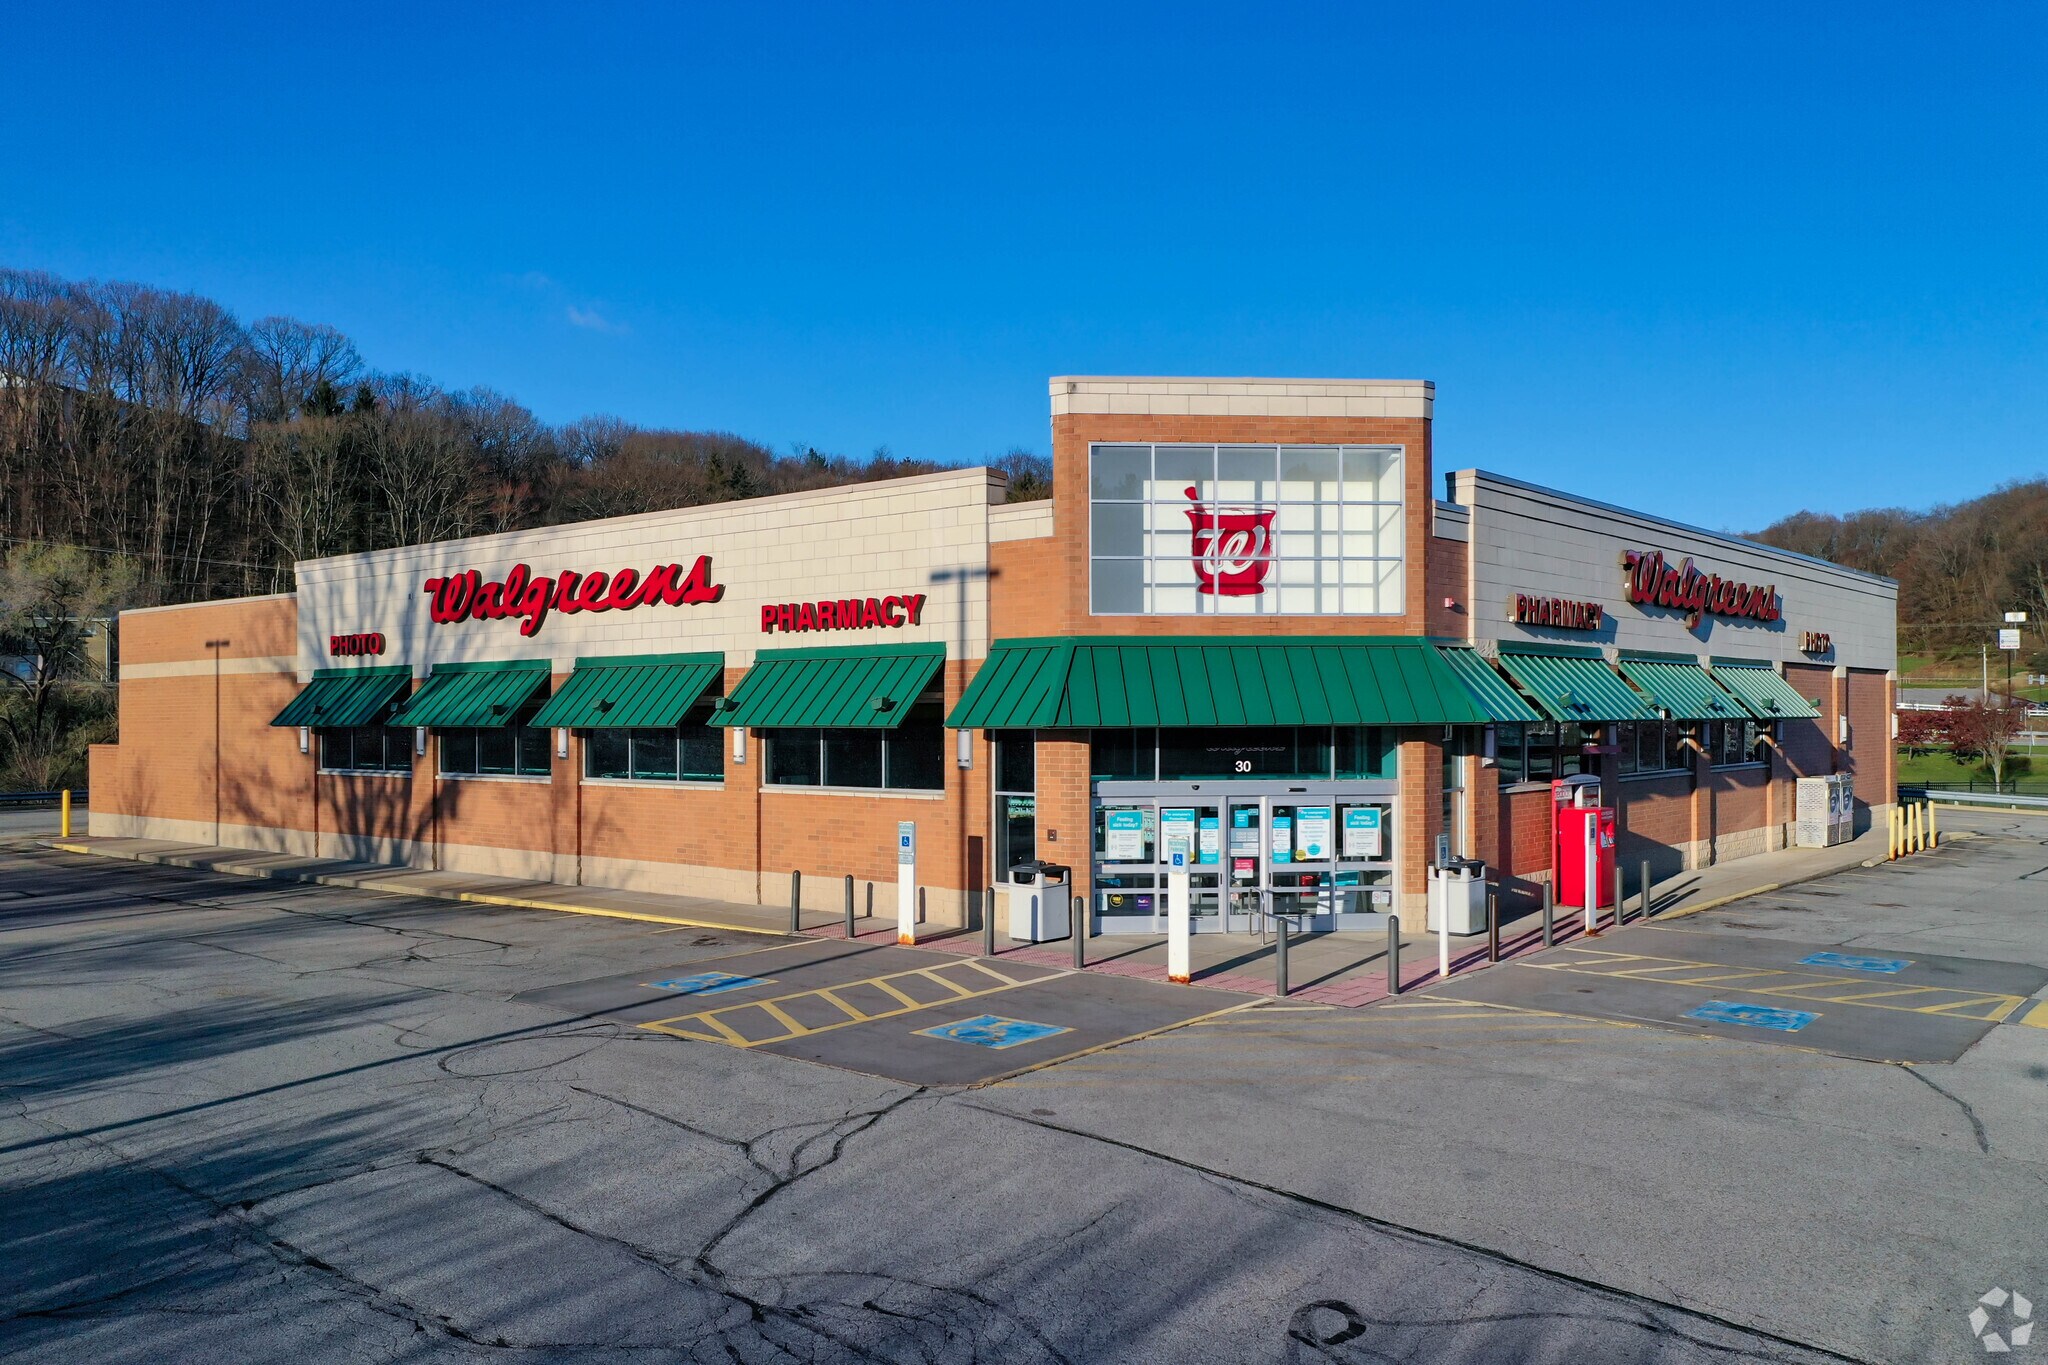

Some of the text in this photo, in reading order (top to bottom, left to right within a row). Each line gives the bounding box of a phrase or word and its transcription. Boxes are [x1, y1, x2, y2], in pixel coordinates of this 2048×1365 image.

[423, 555, 726, 638] Walgreens
[1619, 549, 1780, 630] Walgreens
[761, 593, 927, 635] PHARMACY
[1509, 593, 1603, 631] PHARMACY
[330, 632, 386, 657] PHOTO
[1235, 760, 1252, 773] 30
